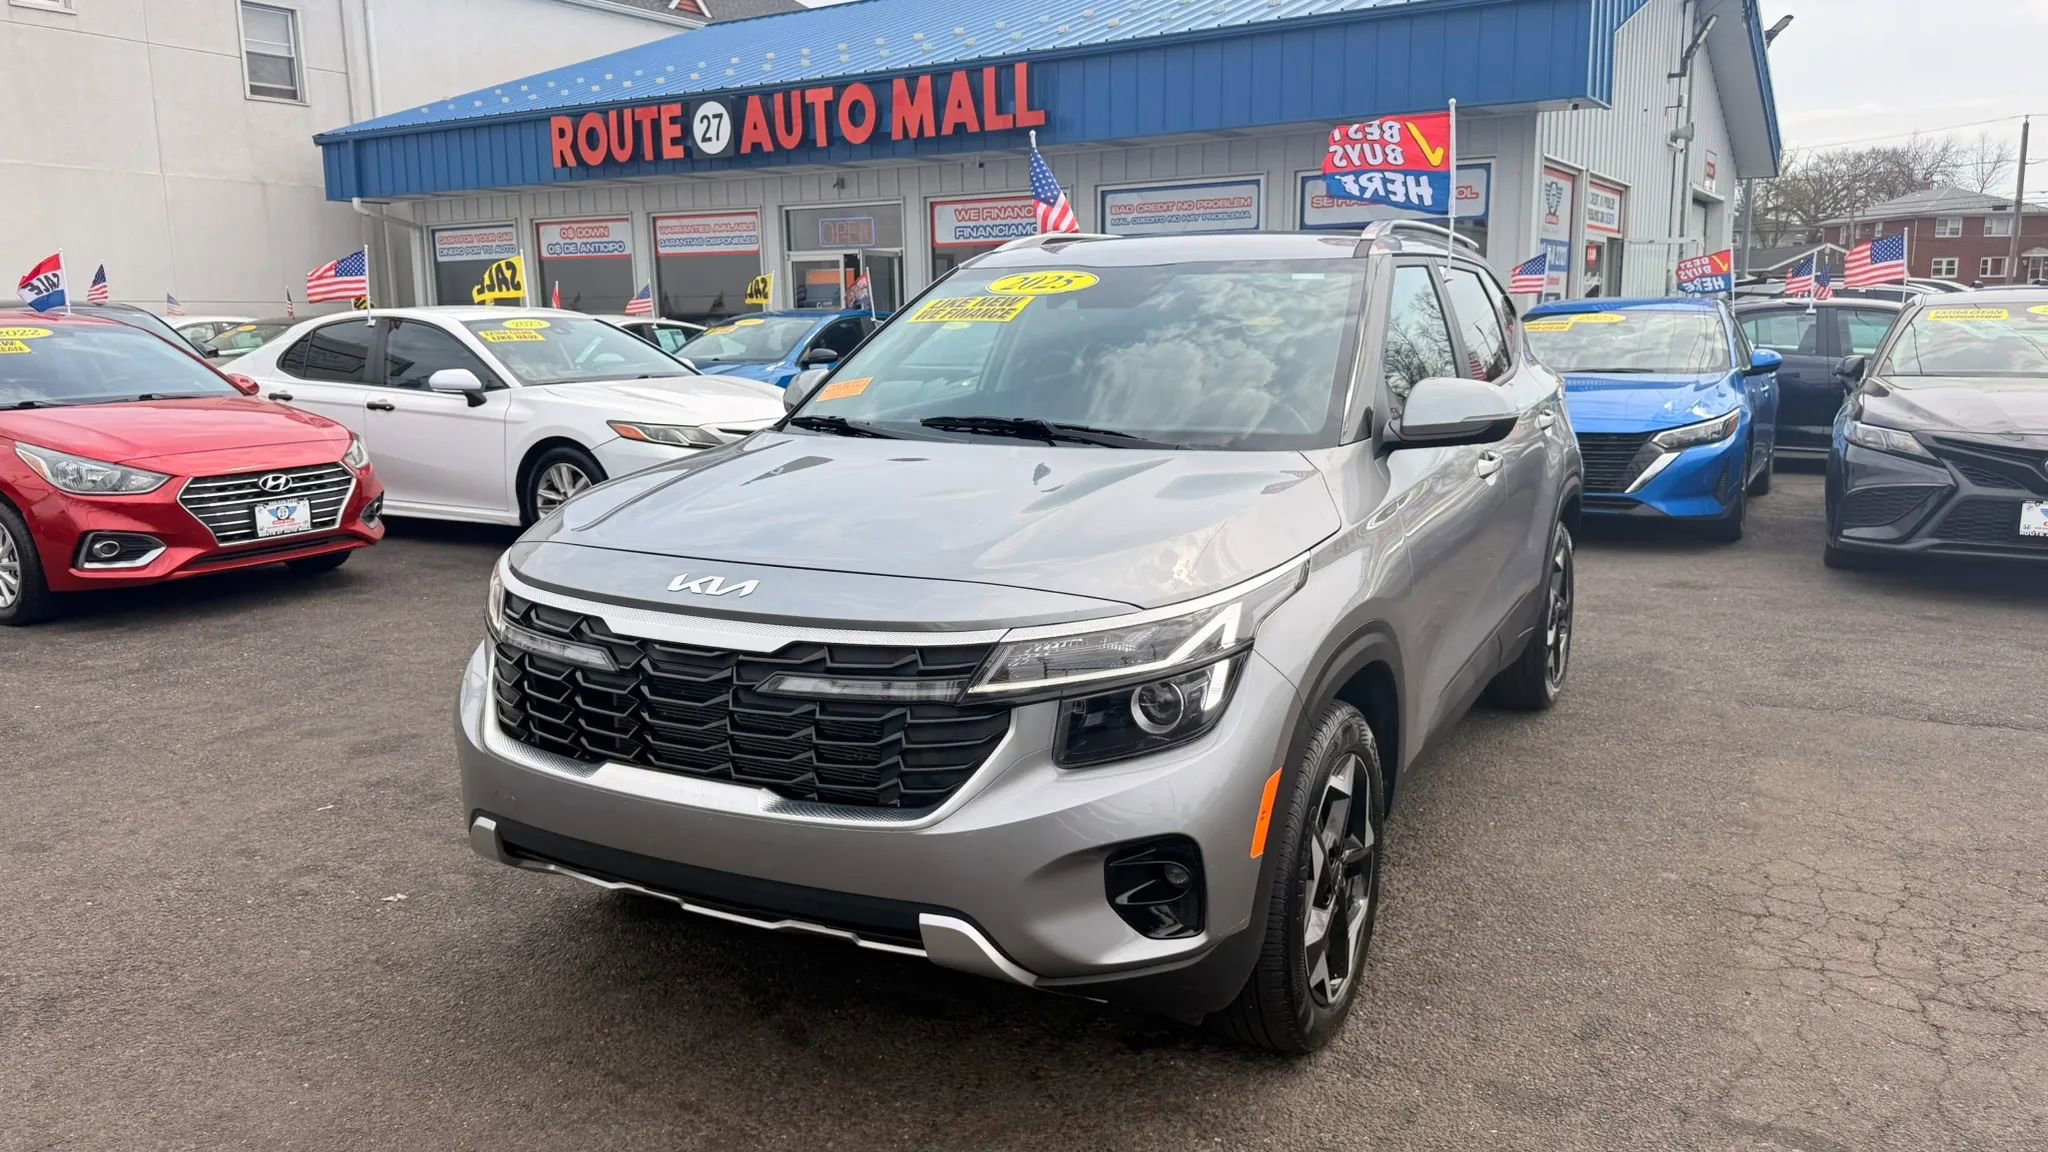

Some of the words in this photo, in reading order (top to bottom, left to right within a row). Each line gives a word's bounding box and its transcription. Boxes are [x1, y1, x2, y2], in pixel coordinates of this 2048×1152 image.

[551, 102, 685, 168] ROUTE
[700, 112, 724, 143] 27
[740, 83, 877, 154] AUTO
[891, 62, 1045, 141] MALL
[954, 208, 980, 222] WE
[981, 204, 1034, 220] FINANC
[1111, 205, 1134, 215] BAD
[1136, 201, 1174, 214] CREDIT
[1177, 200, 1195, 211] NO
[1196, 196, 1252, 209] PROBLEM
[1111, 217, 1130, 226] MAL
[1131, 215, 1166, 225] CREDITO
[1168, 214, 1181, 223] NO
[1182, 213, 1200, 222] HAY
[1201, 211, 1251, 221] PROBLEMA
[475, 232, 496, 243] YOUR
[497, 232, 513, 242] CAR
[576, 226, 608, 238] DOWN
[822, 221, 870, 244] OPEN
[955, 222, 1038, 240] FINANCIAMO
[564, 242, 578, 254] DE
[579, 241, 625, 254] ANTICIPO
[659, 237, 704, 248] GARANTIAS
[705, 235, 758, 246] DISPONIBLES
[439, 246, 464, 256] DINERO
[465, 246, 481, 256] POR
[482, 245, 493, 254] TU
[495, 244, 516, 254] AUTO
[999, 275, 1085, 290] 2025
[932, 298, 975, 308] LIKE
[975, 297, 1024, 307] NEW
[916, 309, 943, 320] WE
[939, 308, 1018, 319] FINANCE
[667, 573, 760, 599] KIA
